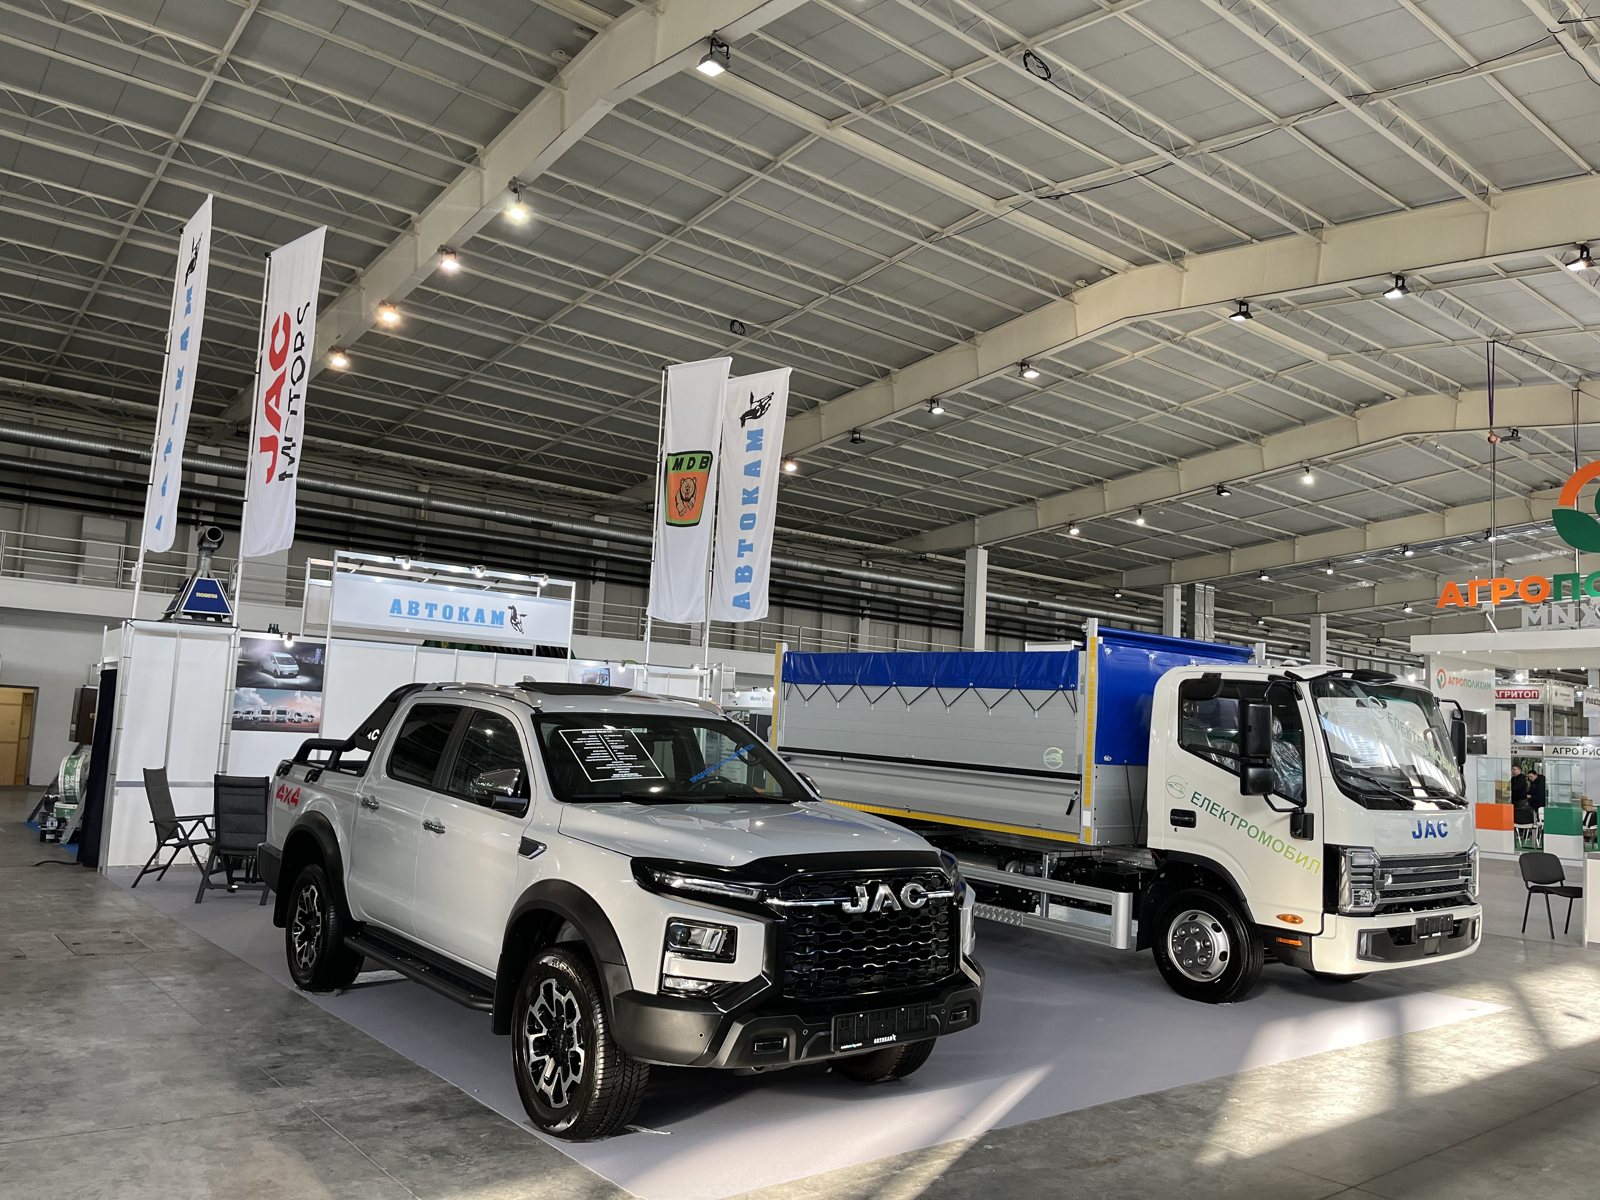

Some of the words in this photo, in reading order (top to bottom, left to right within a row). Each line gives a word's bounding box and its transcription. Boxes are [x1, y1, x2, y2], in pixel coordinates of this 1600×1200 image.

[259, 311, 291, 485] JAC
[671, 456, 710, 472] MDB
[732, 428, 764, 610] АВТОКАМ
[389, 598, 505, 626] АВТОКАМ
[1552, 747, 1579, 755] АГРО
[1190, 791, 1321, 875] ЕЛЕКТРОМОБИЛ
[1411, 820, 1449, 839] JAC
[841, 882, 928, 914] JAC
